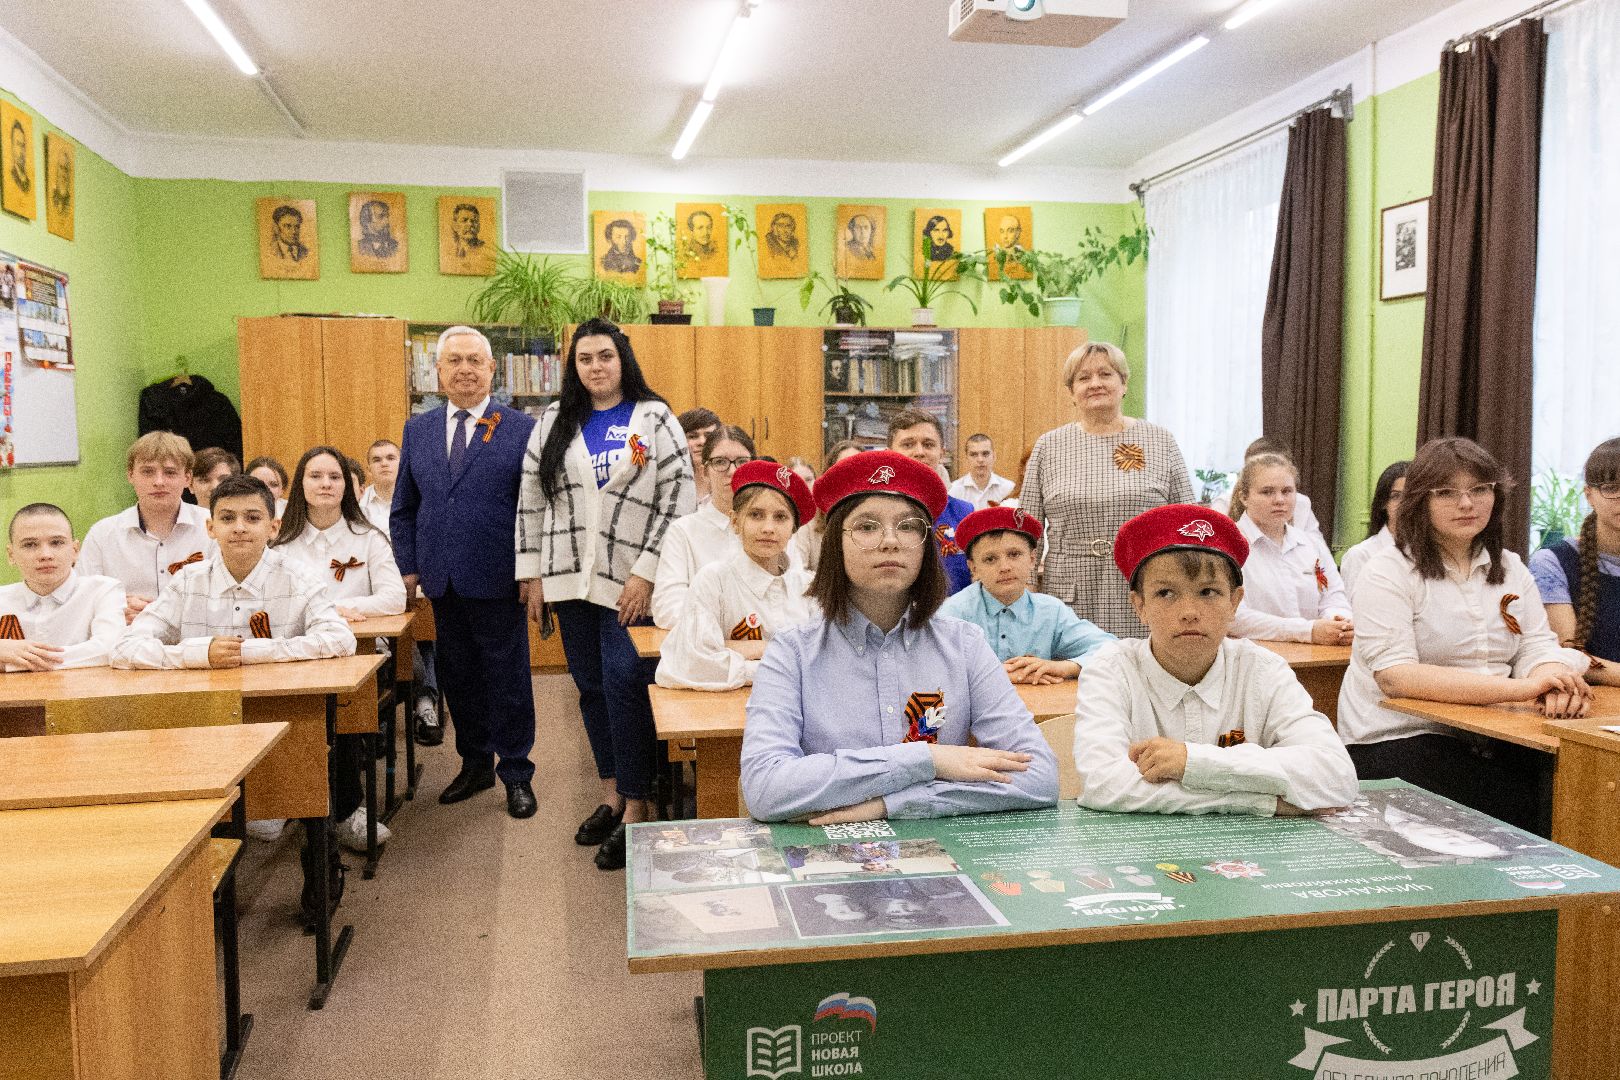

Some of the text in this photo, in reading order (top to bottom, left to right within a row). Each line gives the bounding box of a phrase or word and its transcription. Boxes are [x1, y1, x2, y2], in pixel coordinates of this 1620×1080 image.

[1292, 884, 1433, 899] ЧИЧКАНОВА
[1317, 972, 1516, 1022] ПАРТА ГЕРОЯ
[811, 1030, 863, 1046] ПРОЕКТ
[811, 1046, 859, 1061] НОВАЯ
[811, 1061, 863, 1077] ШКОЛА
